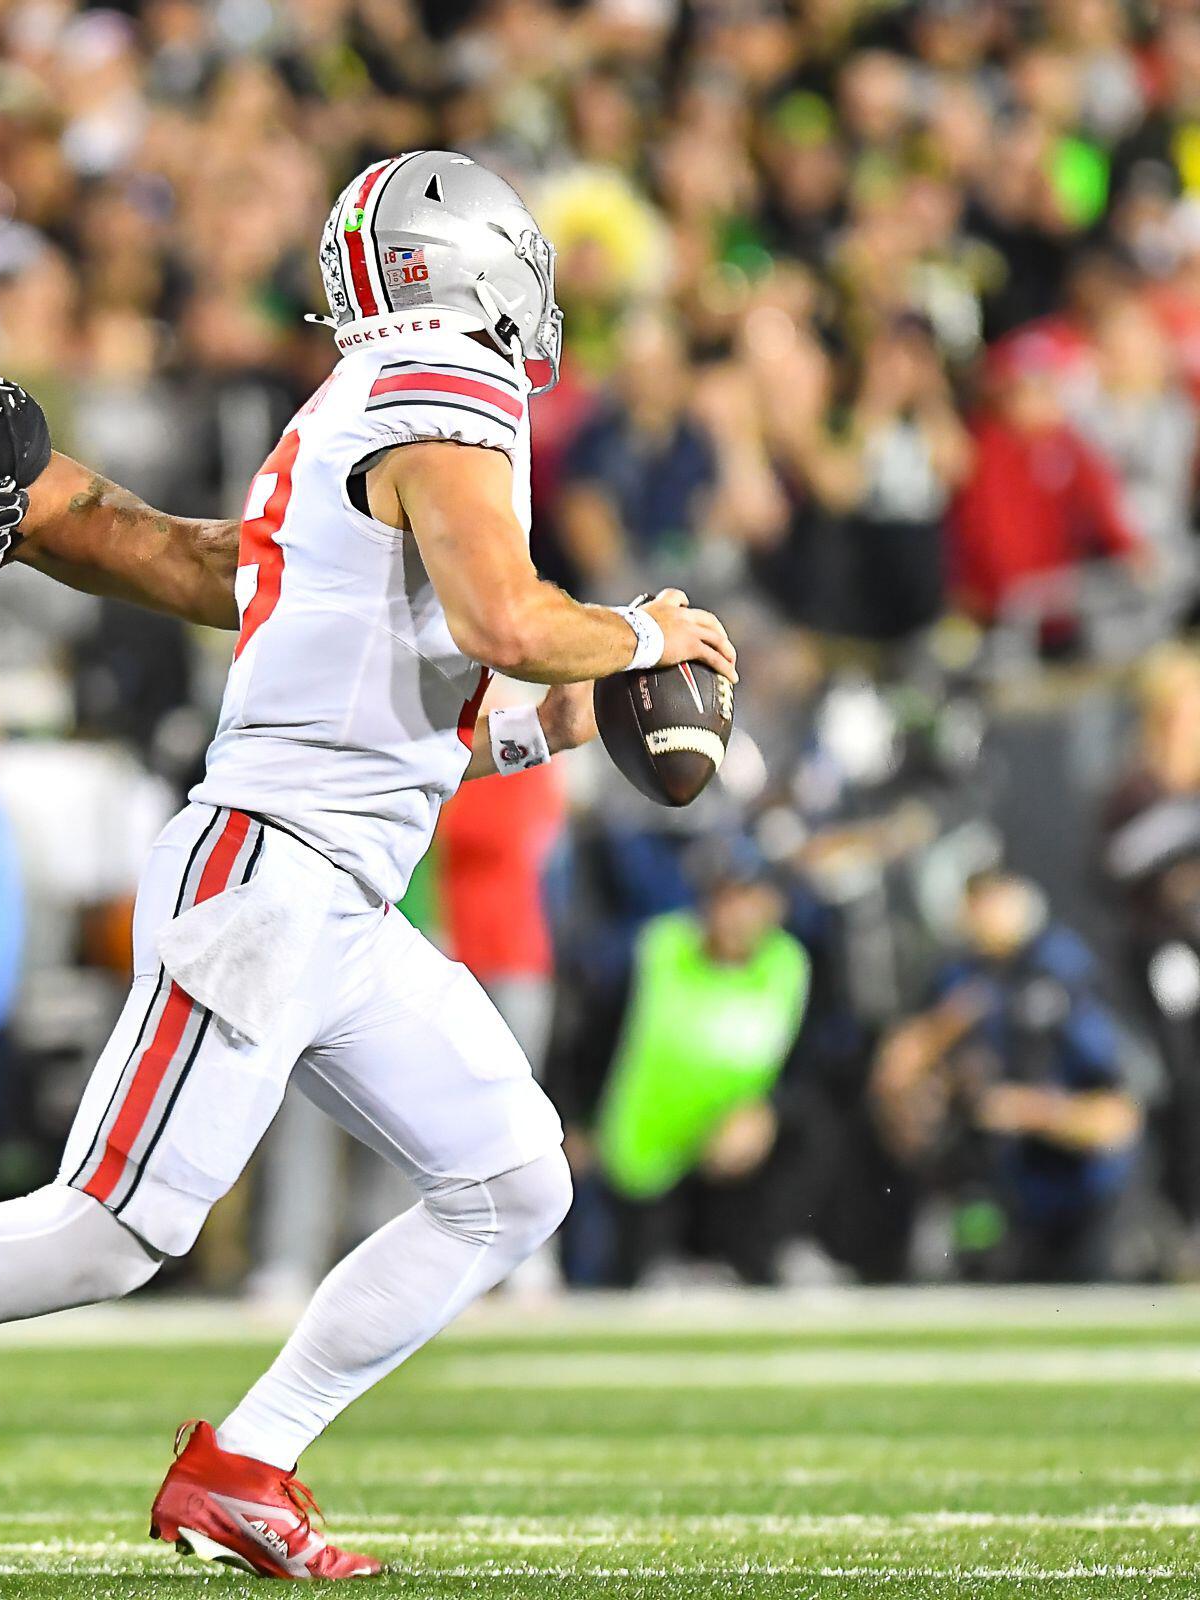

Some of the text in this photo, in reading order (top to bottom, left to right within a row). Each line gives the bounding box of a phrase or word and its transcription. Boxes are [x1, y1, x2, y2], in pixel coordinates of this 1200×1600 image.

[383, 252, 397, 264] 18
[338, 319, 441, 349] BUCKEYES
[249, 1520, 288, 1560] ALPHA
